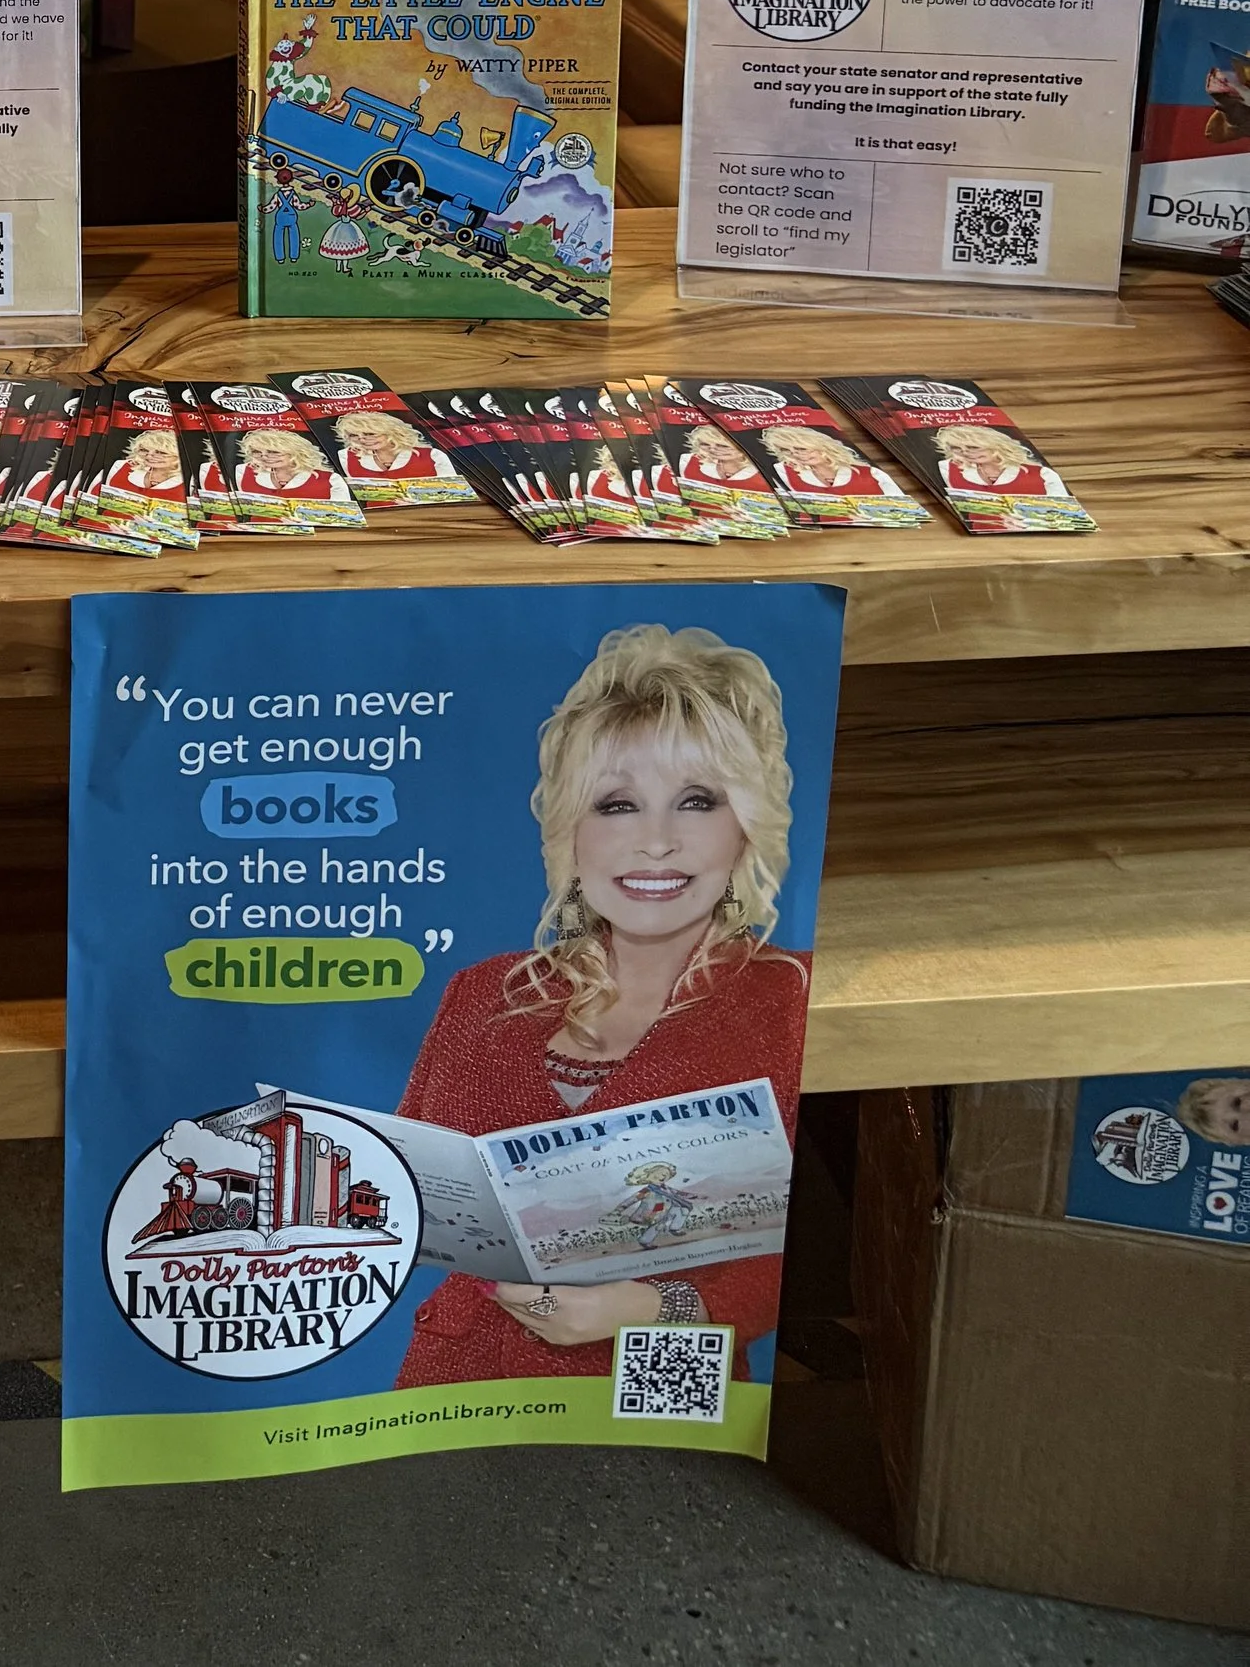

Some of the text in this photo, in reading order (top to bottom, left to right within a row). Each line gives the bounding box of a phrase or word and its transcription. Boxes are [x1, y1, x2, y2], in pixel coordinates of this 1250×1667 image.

[11, 15, 29, 24] we
[33, 13, 65, 23] have
[331, 14, 419, 41] THAT
[1, 30, 18, 41] for
[22, 29, 33, 40] it!
[426, 59, 579, 79] by WATTY PIPER
[545, 97, 579, 105] ORIGINAL
[552, 87, 565, 95] THE
[719, 162, 845, 180] Not sure who to
[718, 184, 834, 200] contact? Scan
[717, 201, 852, 221] the QR code and
[1147, 194, 1250, 222] DOLLY
[716, 223, 758, 236] scroll
[762, 225, 779, 237] to
[824, 230, 850, 245] my
[348, 270, 353, 278] A
[362, 270, 394, 278] PLATT
[418, 270, 451, 278] MUNK
[249, 692, 319, 719] can
[335, 690, 453, 717] never
[179, 725, 422, 776] get enough
[221, 783, 378, 824] books
[150, 848, 445, 885] into the hands
[189, 893, 402, 938] of enough
[503, 1090, 760, 1165] DOLLY PARTON
[1204, 1151, 1242, 1233] LOVE
[124, 1262, 400, 1319] IMAGINATION
[172, 1309, 353, 1362] LIBRARY
[263, 1403, 566, 1445] Visit ImaginationLibrary.com
